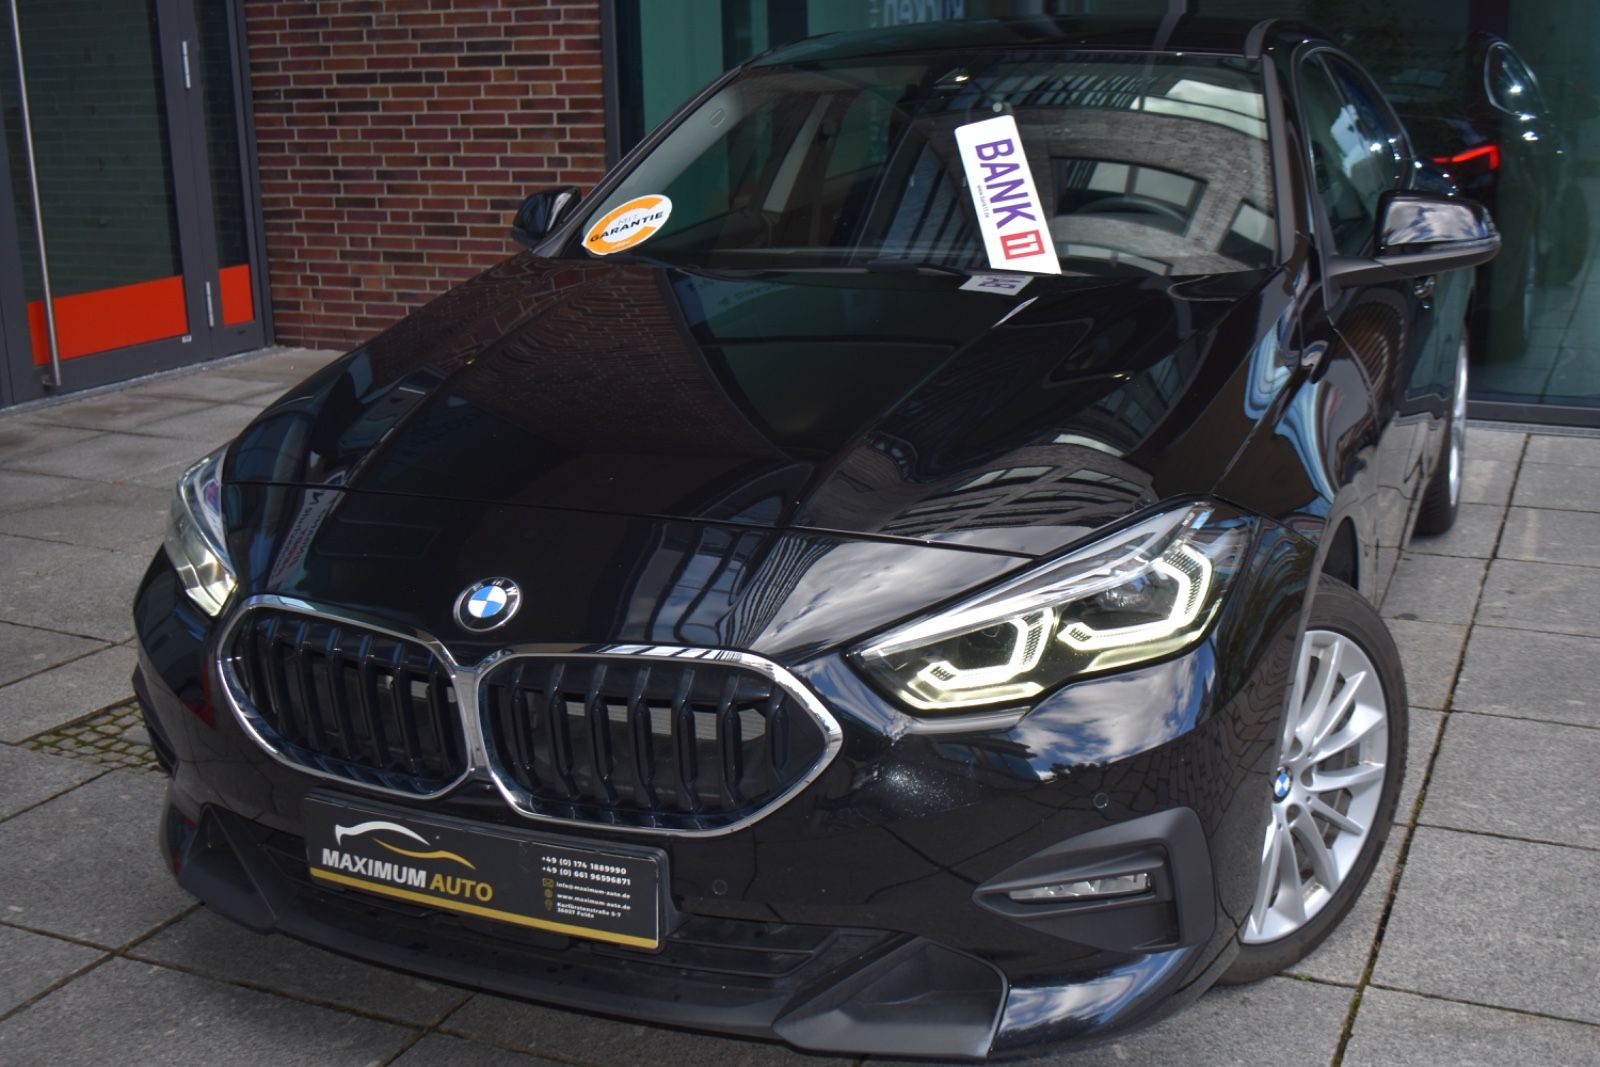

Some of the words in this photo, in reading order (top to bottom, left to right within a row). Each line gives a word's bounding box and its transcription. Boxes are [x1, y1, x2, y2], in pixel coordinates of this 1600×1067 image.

[975, 138, 1037, 230] BANK
[590, 211, 664, 242] GARANTIE
[541, 856, 557, 864] +49
[559, 858, 571, 867] (0)
[573, 860, 588, 869] 174
[322, 848, 427, 888] MAXIMUM
[430, 874, 494, 902] AUTO
[542, 866, 557, 874] +49
[559, 868, 571, 877] (0)
[574, 870, 588, 879] 661
[556, 882, 631, 899] info@maximum-auto.de
[556, 894, 631, 910] www.maximum-auto.de
